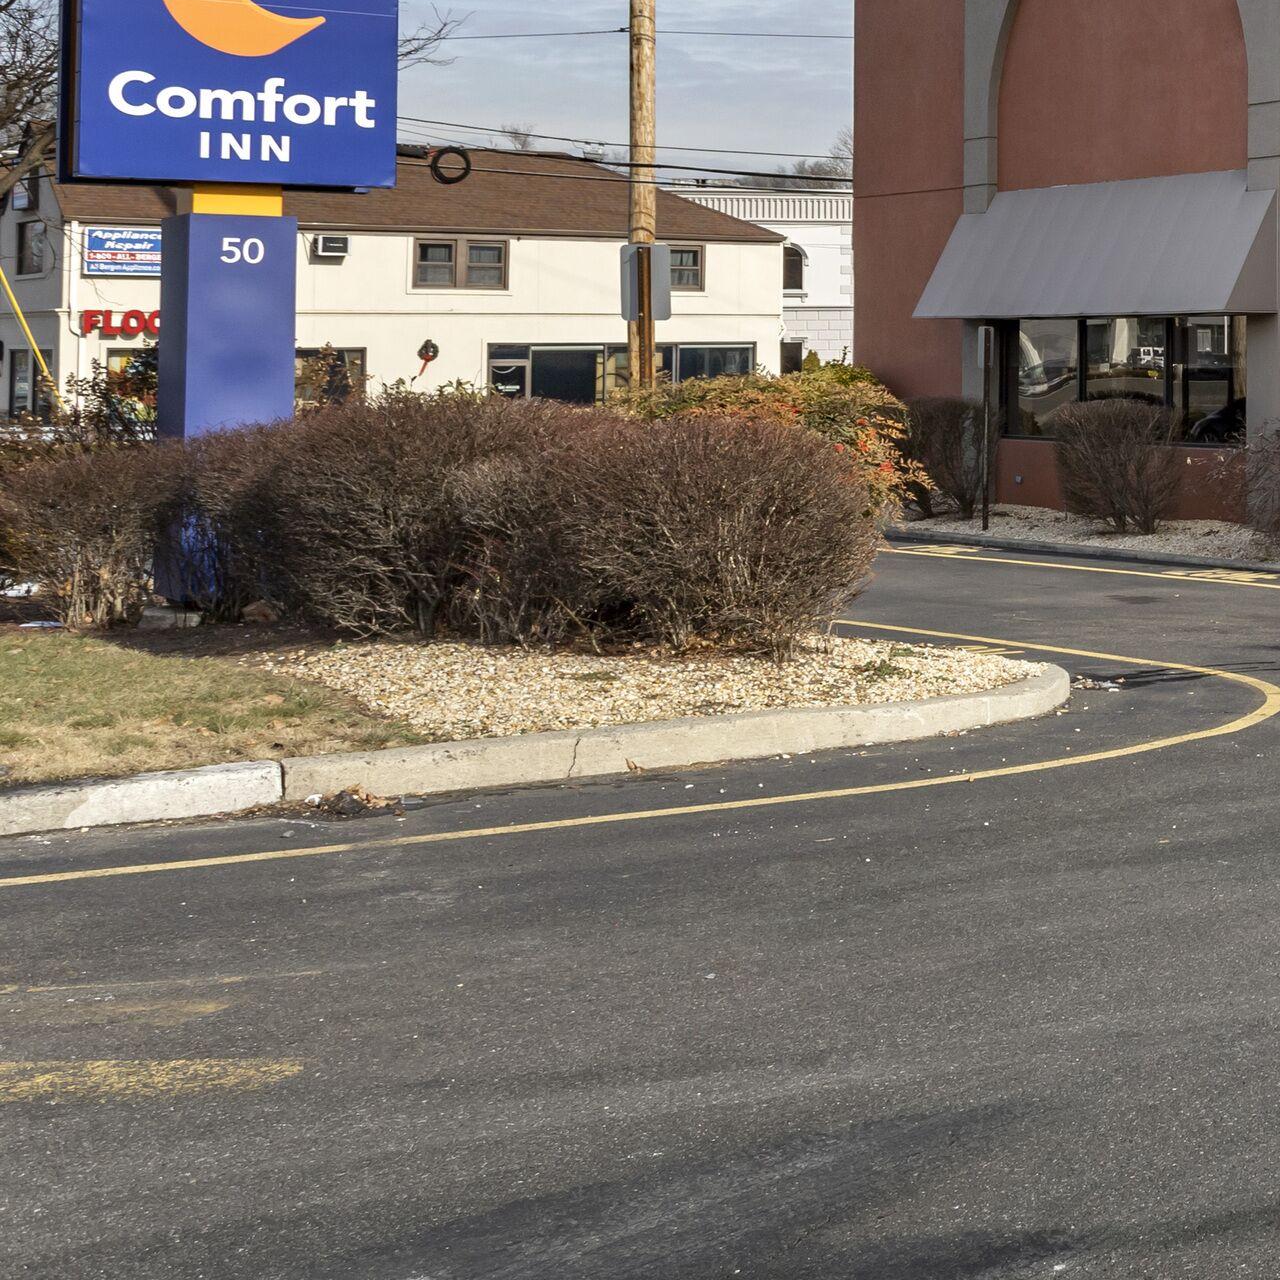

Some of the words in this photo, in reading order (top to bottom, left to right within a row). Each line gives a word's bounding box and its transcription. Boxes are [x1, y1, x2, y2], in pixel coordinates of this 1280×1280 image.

[108, 70, 376, 128] Comfort
[200, 131, 290, 162] INN
[104, 241, 154, 250] Repair
[220, 237, 264, 264] 50
